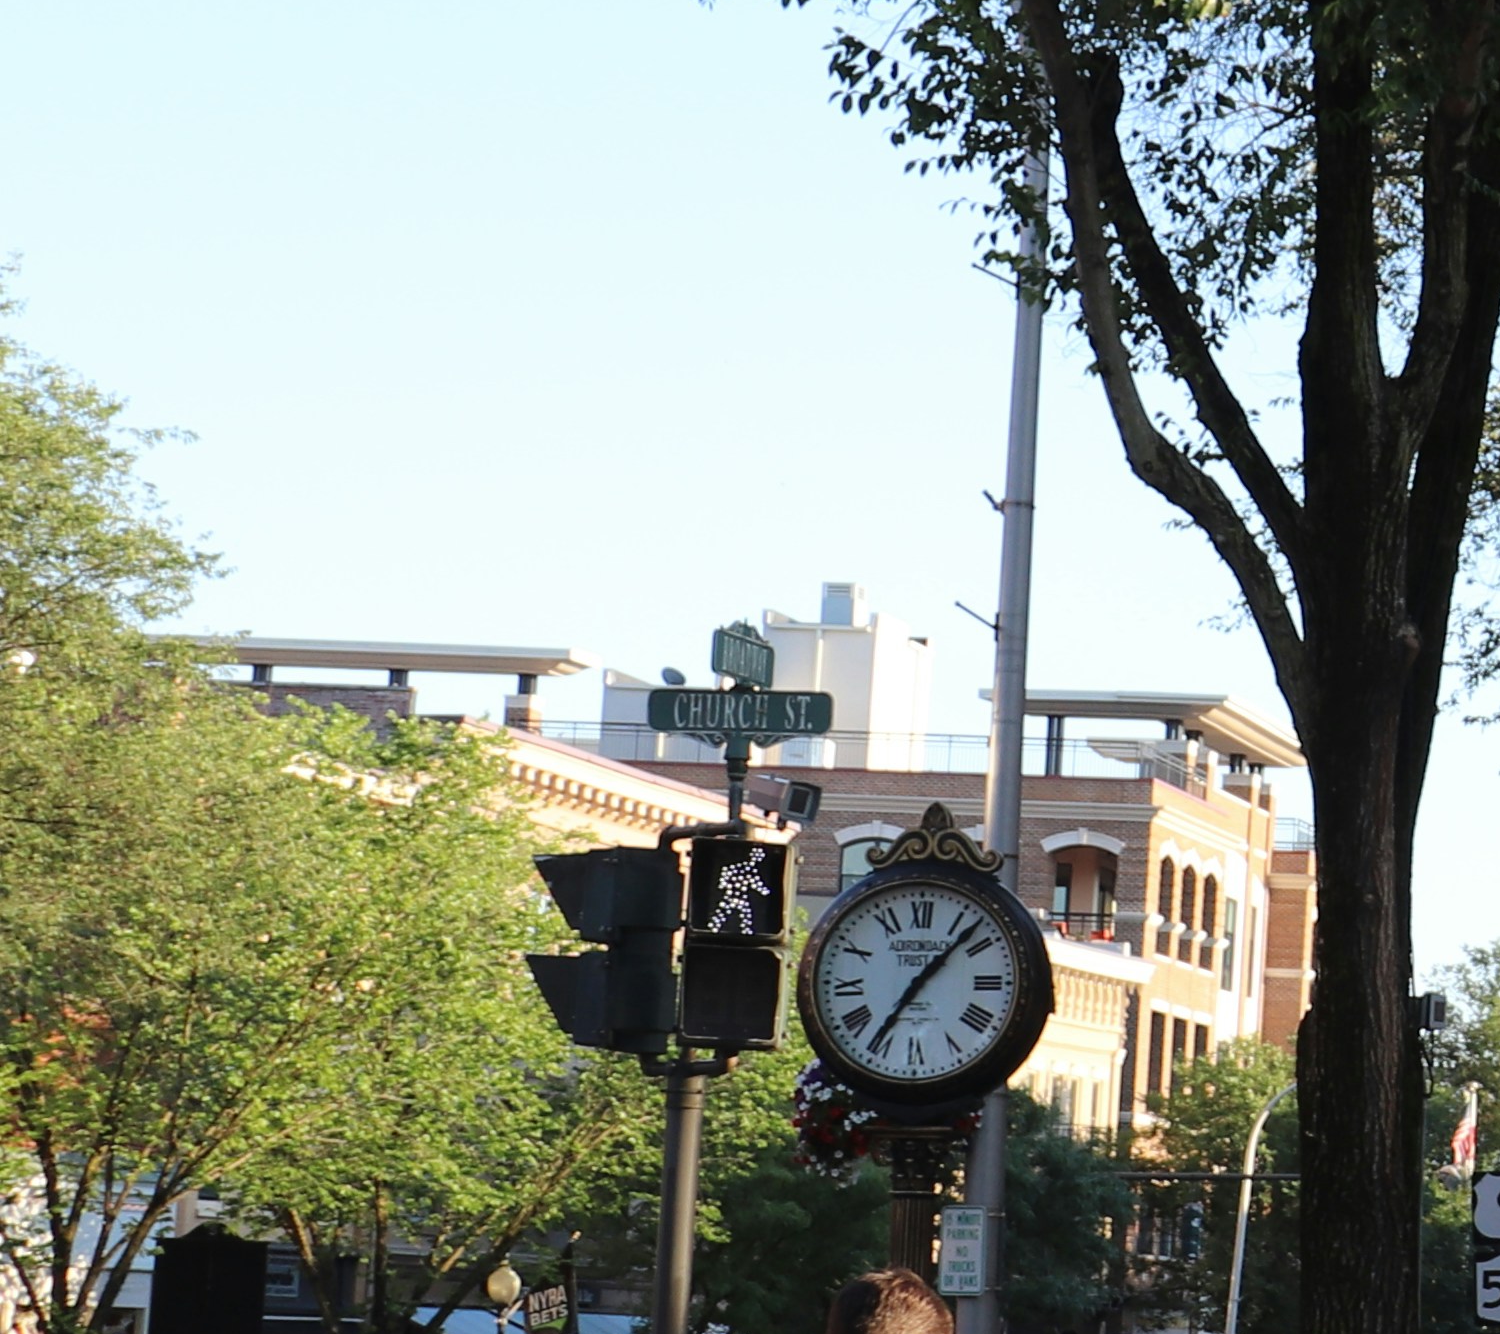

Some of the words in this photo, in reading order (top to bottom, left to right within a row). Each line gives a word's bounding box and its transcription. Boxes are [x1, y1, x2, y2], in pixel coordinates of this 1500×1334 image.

[674, 693, 769, 729] CHURCH
[784, 695, 813, 730] ST.
[946, 1228, 979, 1240] PARKING
[956, 1246, 968, 1257] NO
[948, 1261, 975, 1272] TRUCKS
[528, 1284, 568, 1313] NYRA
[530, 1304, 569, 1326] BETS
